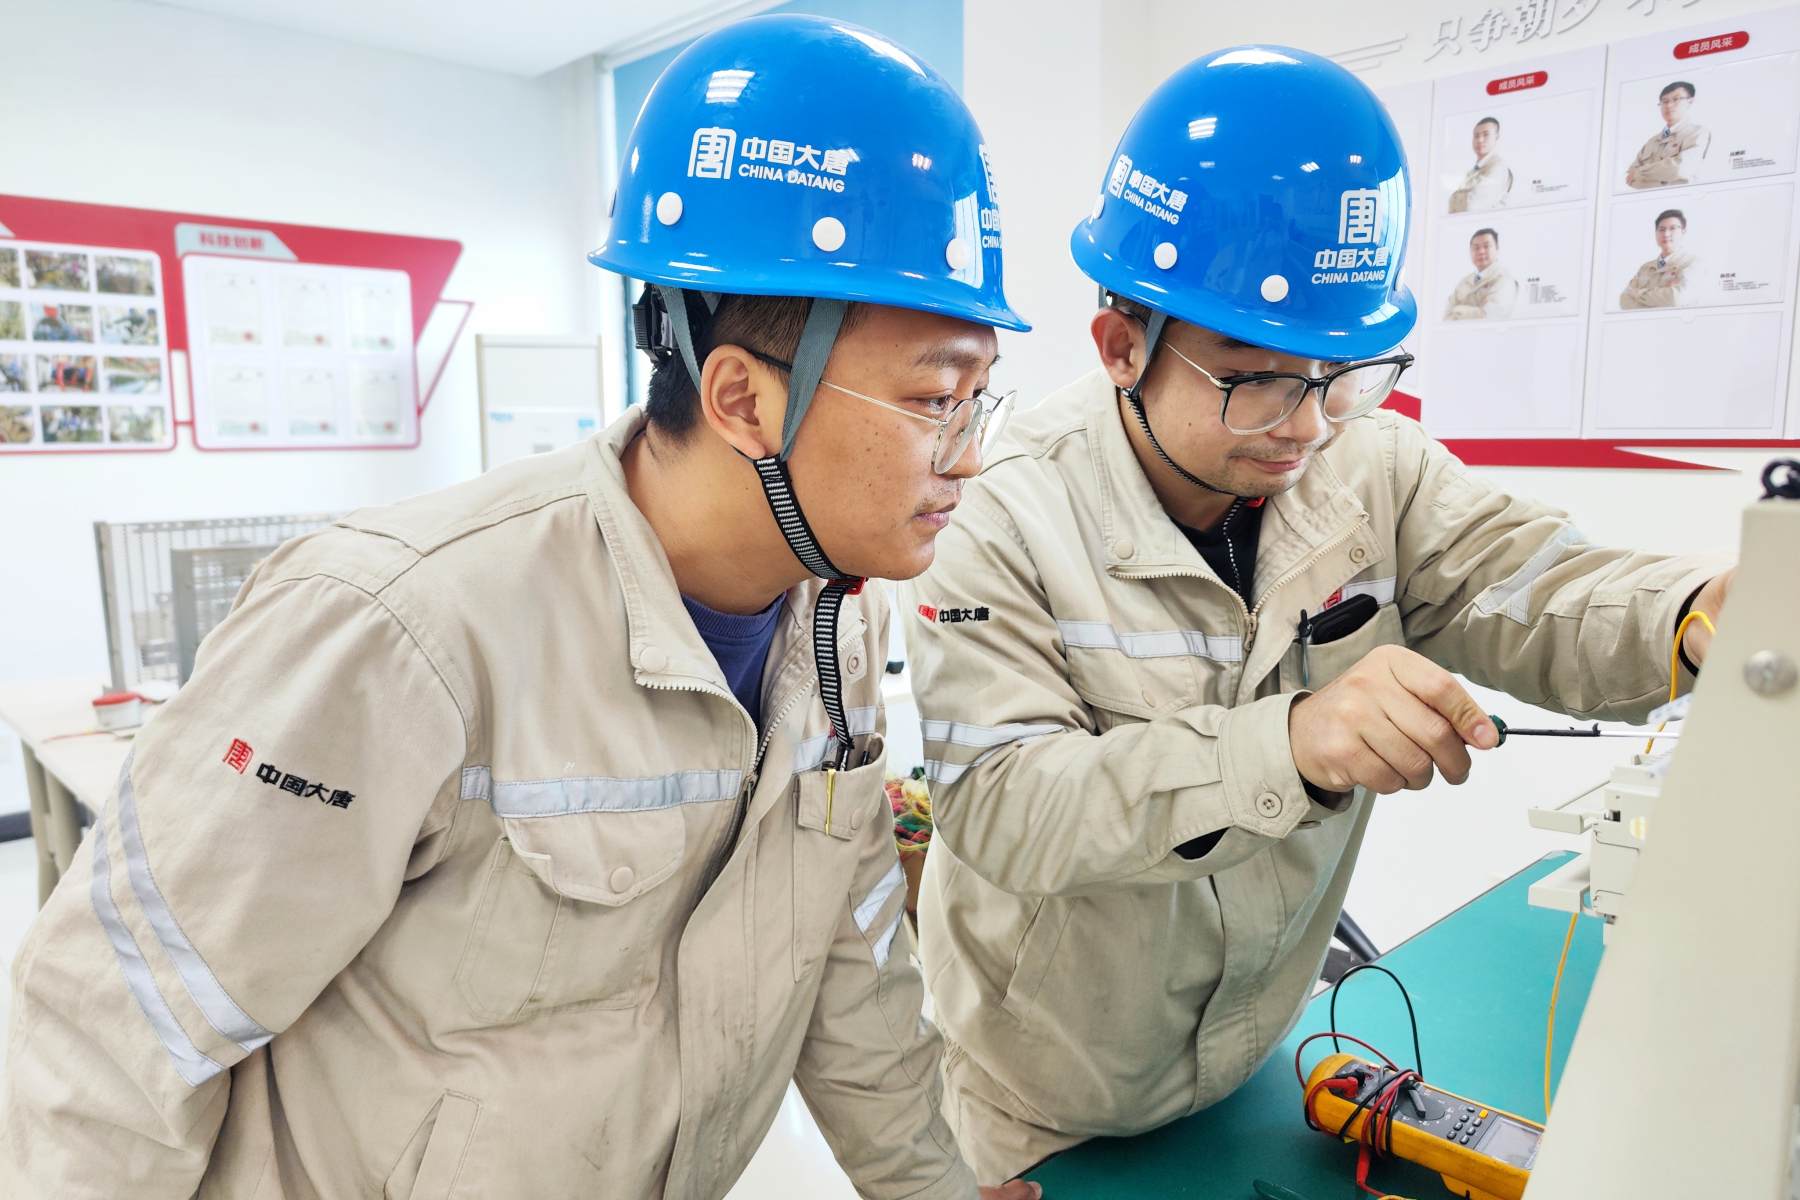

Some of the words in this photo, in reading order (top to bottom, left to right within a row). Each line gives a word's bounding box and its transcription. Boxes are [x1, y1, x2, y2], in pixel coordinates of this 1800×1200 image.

[1689, 36, 1735, 54] 成员风采
[741, 137, 850, 176] 中国大唐
[738, 164, 784, 182] CHINA
[785, 169, 845, 193] DATANG
[1128, 169, 1188, 212] 中国大唐
[1123, 189, 1145, 209] CHINA
[1144, 200, 1180, 225] DATANG
[1314, 247, 1390, 270] 中国大唐
[1311, 272, 1348, 285] CHINA
[1350, 269, 1386, 283] DATANG
[939, 606, 990, 624] 中国大唐
[255, 762, 356, 810] 中国大唐
